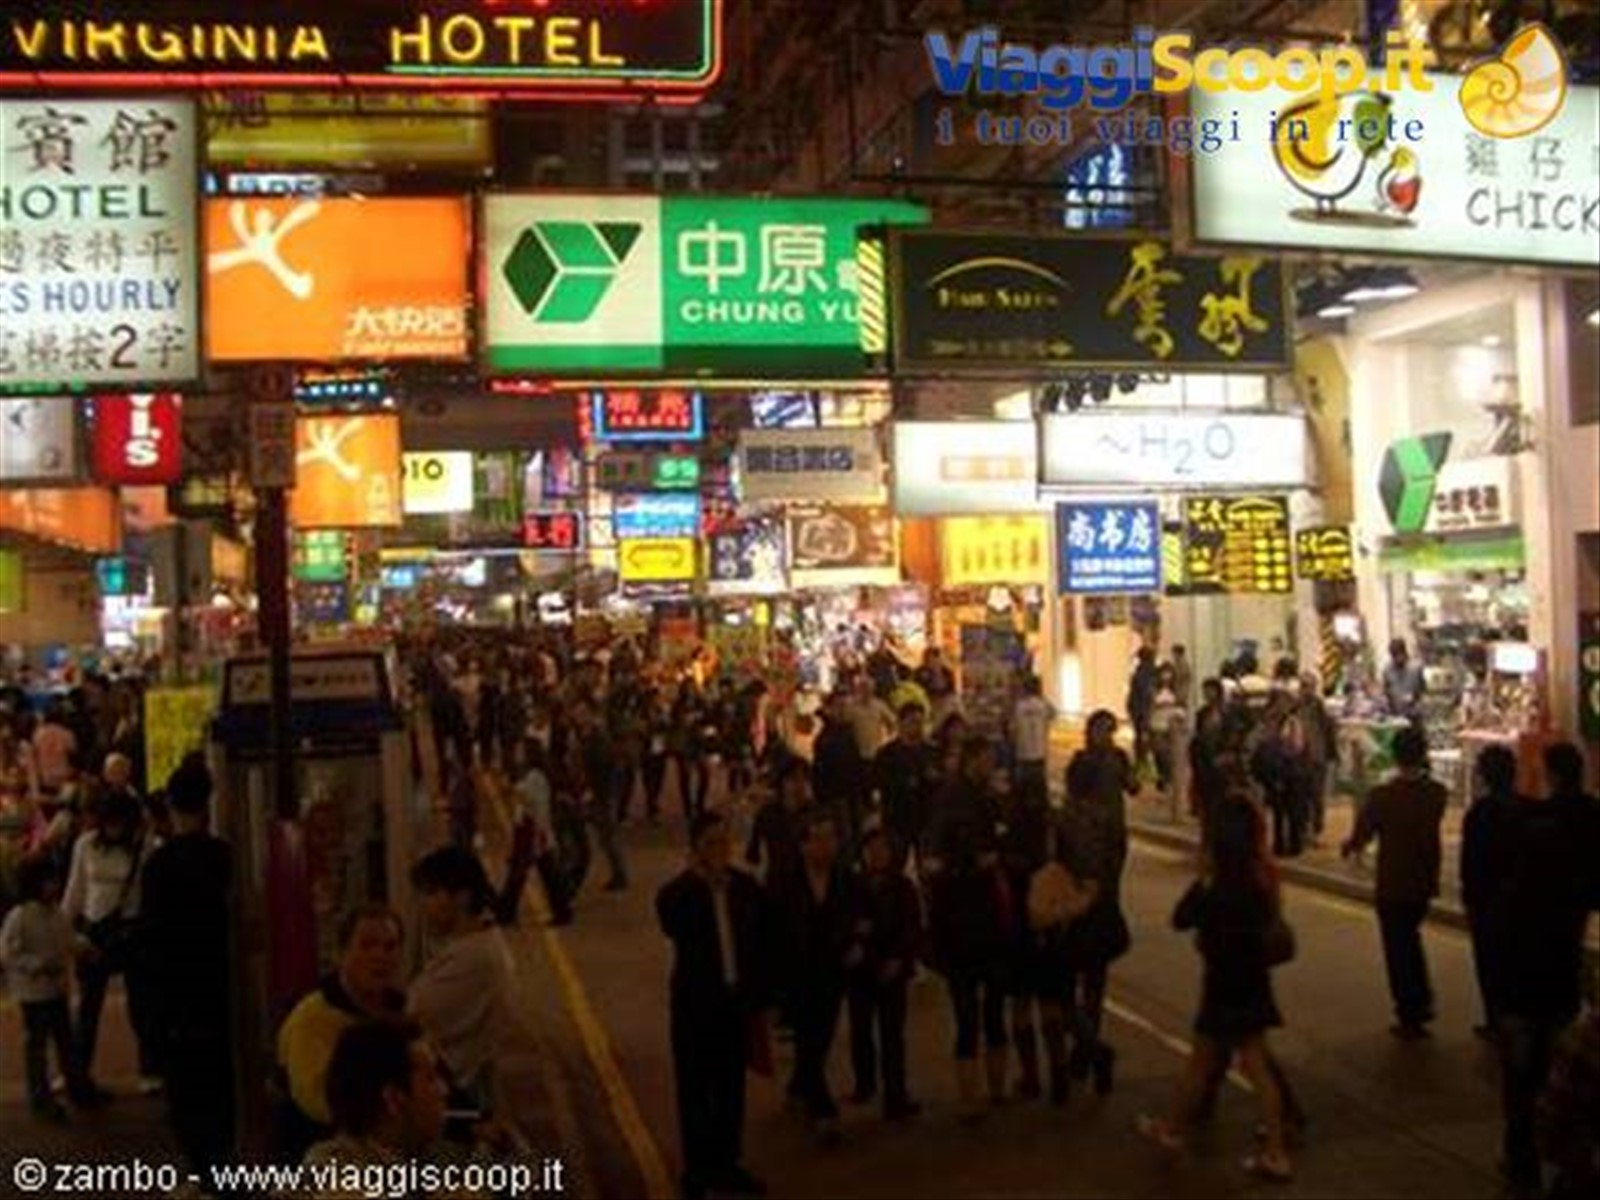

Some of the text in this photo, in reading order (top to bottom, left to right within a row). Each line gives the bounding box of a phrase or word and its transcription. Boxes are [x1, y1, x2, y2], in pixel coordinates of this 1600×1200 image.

[391, 14, 625, 64] HOTEL
[6, 107, 178, 176] 賓館
[678, 219, 858, 294] 中原
[0, 278, 181, 313] S HOURLY
[681, 302, 805, 324] CHUNG
